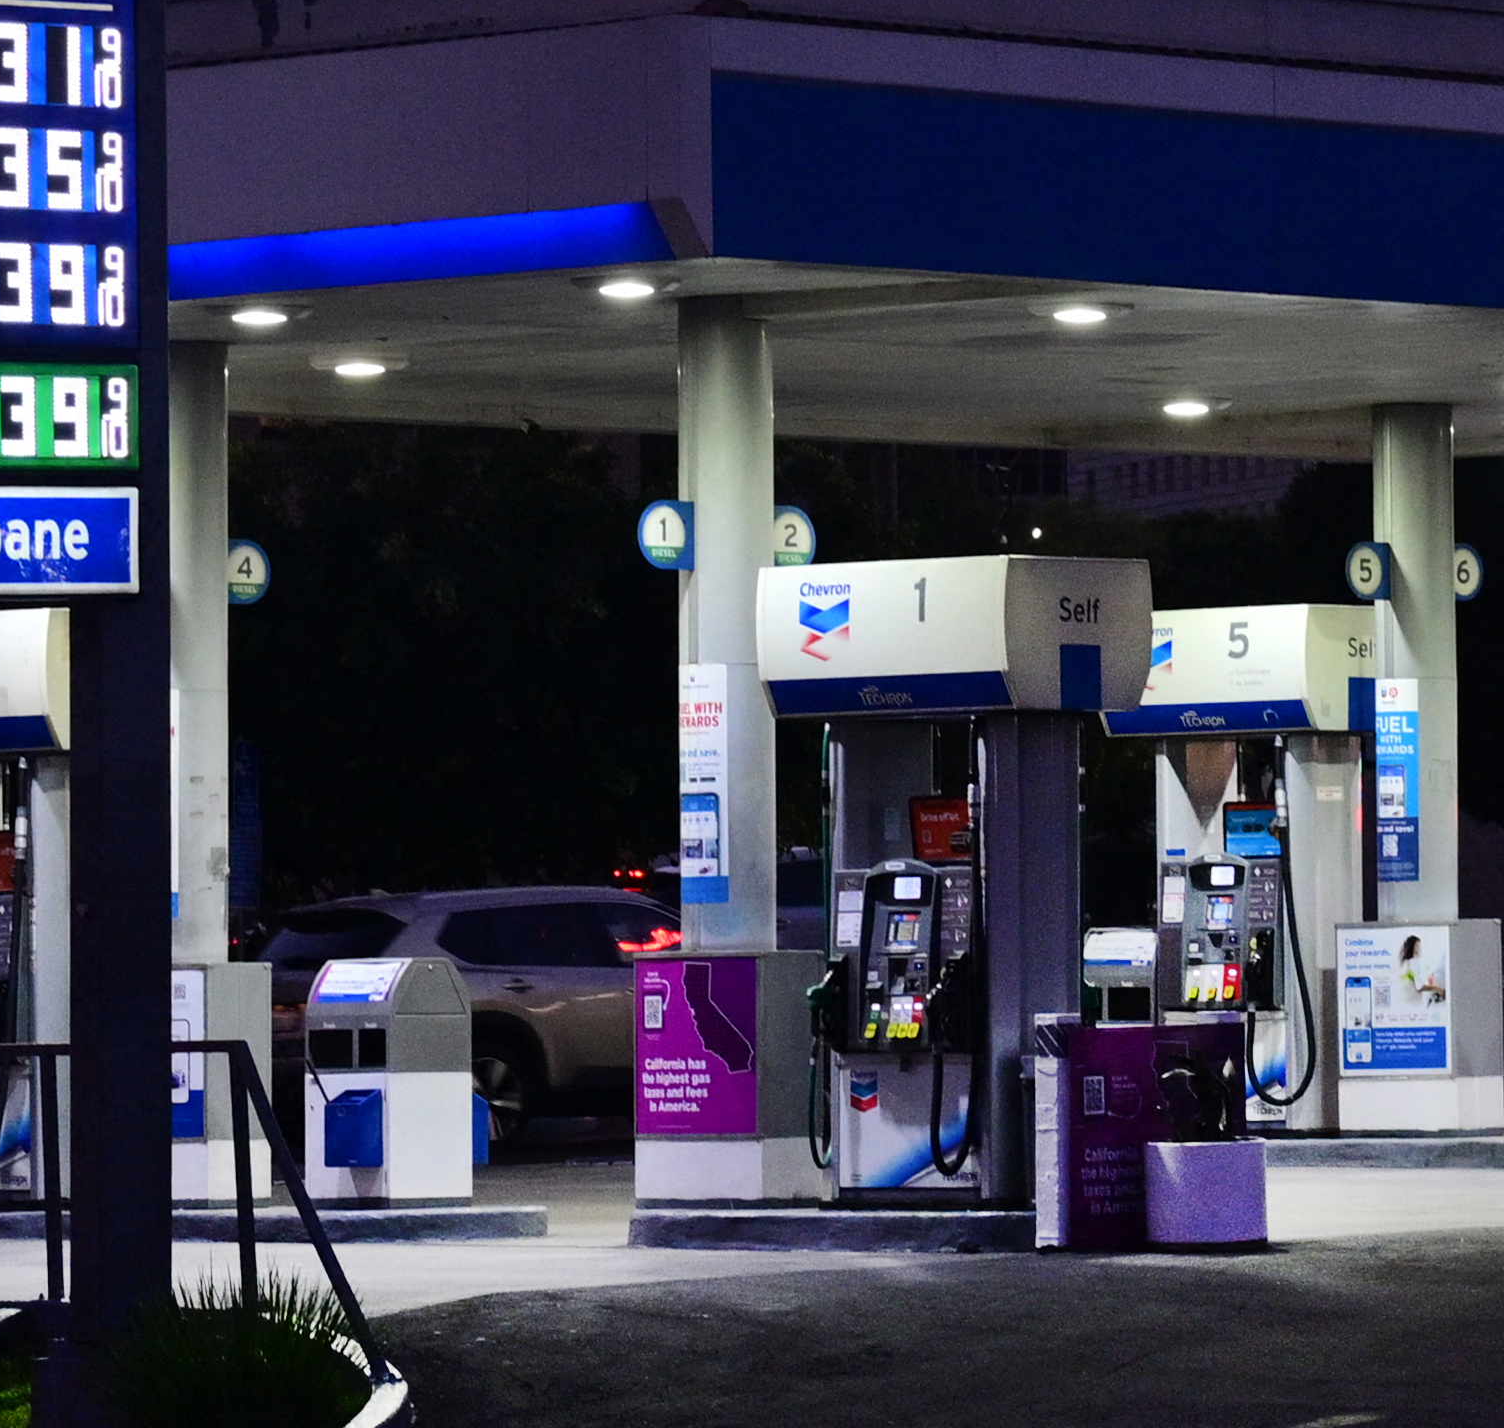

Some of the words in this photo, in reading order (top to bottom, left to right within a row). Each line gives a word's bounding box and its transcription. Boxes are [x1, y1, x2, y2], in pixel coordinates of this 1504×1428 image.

[659, 517, 667, 542] 1
[784, 523, 798, 547] 2
[651, 548, 677, 558] DIESEL
[237, 556, 253, 579] 4
[1359, 558, 1372, 583] 5
[1457, 560, 1470, 584] 6
[799, 582, 851, 597] Chevron
[914, 577, 926, 622] 1
[1058, 596, 1101, 623] Self
[1227, 621, 1250, 659] 5
[1348, 637, 1377, 659] Sel
[694, 702, 723, 714] WITH
[645, 1057, 686, 1070] California
[688, 1057, 707, 1070] has
[642, 1072, 655, 1084] the
[656, 1072, 690, 1086] highest
[692, 1073, 711, 1085] gas
[644, 1087, 665, 1098] taxes
[666, 1086, 684, 1098] and
[686, 1086, 708, 1098] fees
